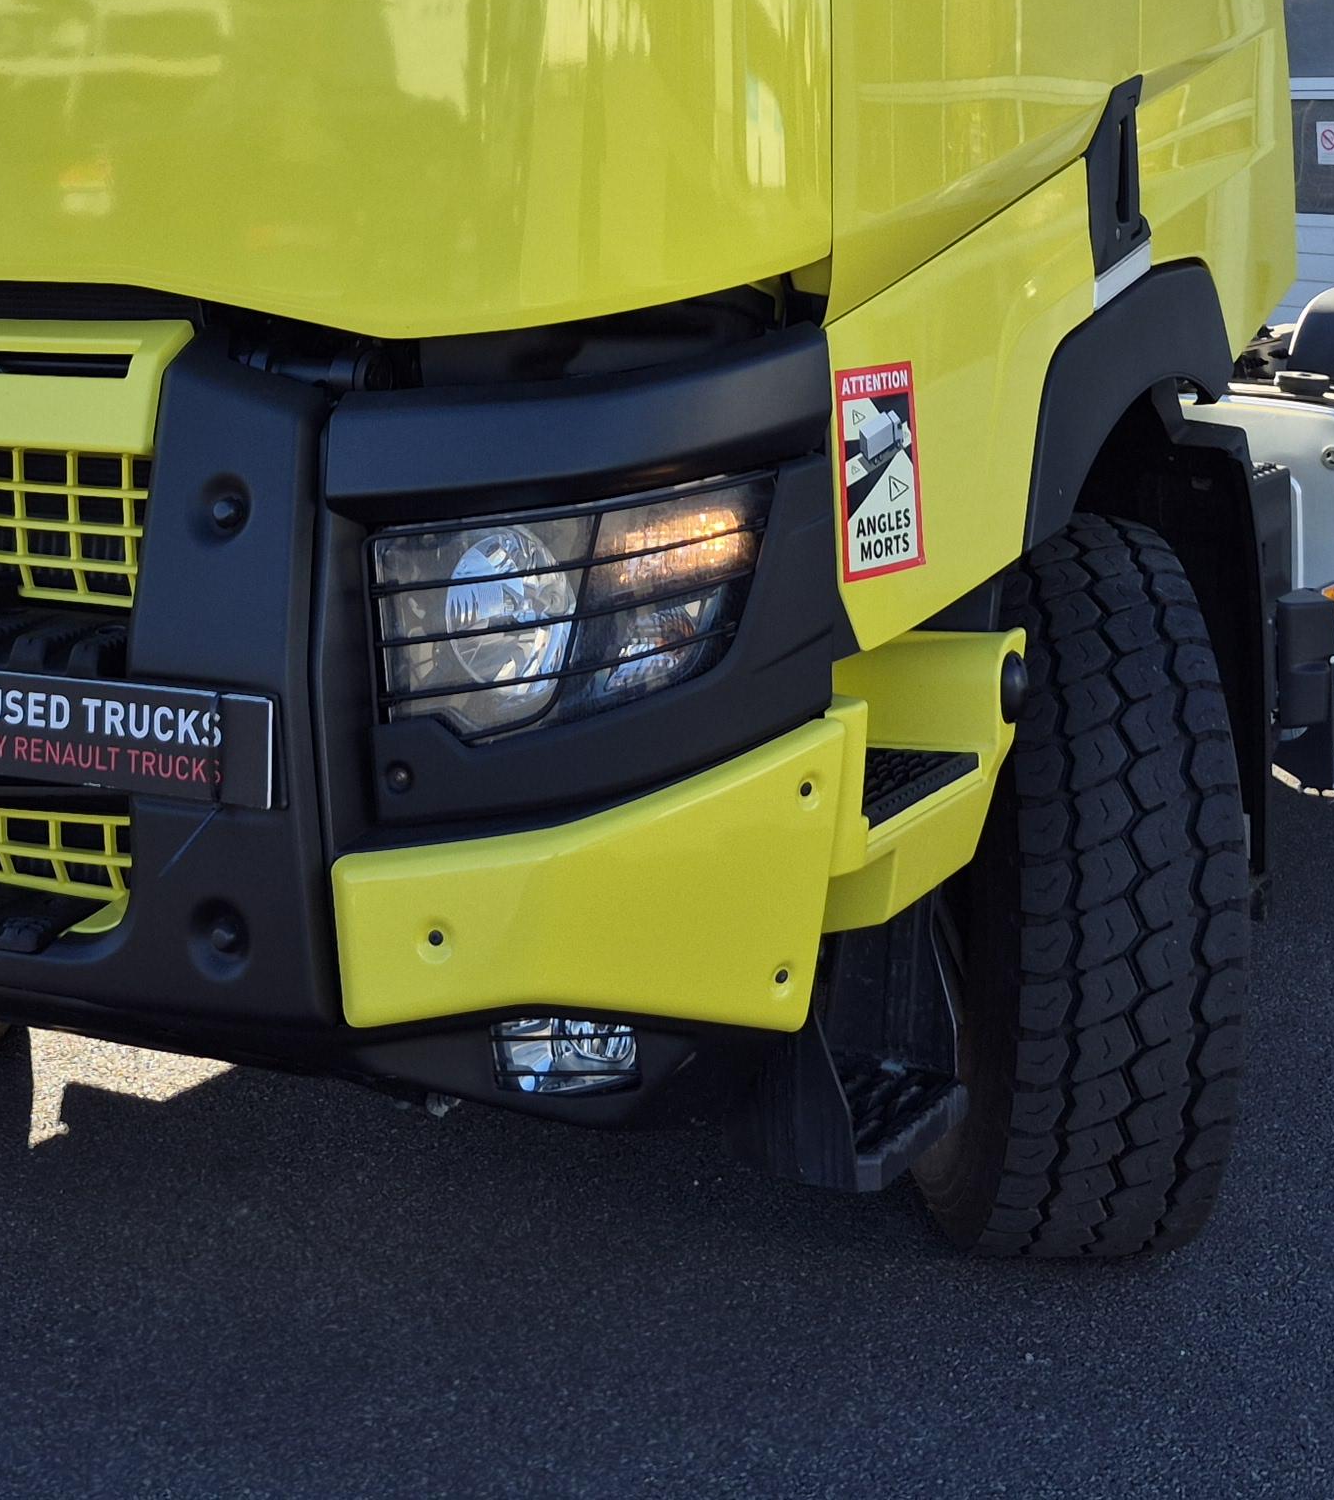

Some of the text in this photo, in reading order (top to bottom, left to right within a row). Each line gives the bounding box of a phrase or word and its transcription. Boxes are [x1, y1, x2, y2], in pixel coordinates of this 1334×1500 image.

[841, 370, 908, 396] ATTENTION
[856, 508, 911, 539] ANGLES
[860, 533, 909, 562] MORTS
[82, 698, 222, 748] TRUCKS
[15, 736, 120, 771] RENAULT
